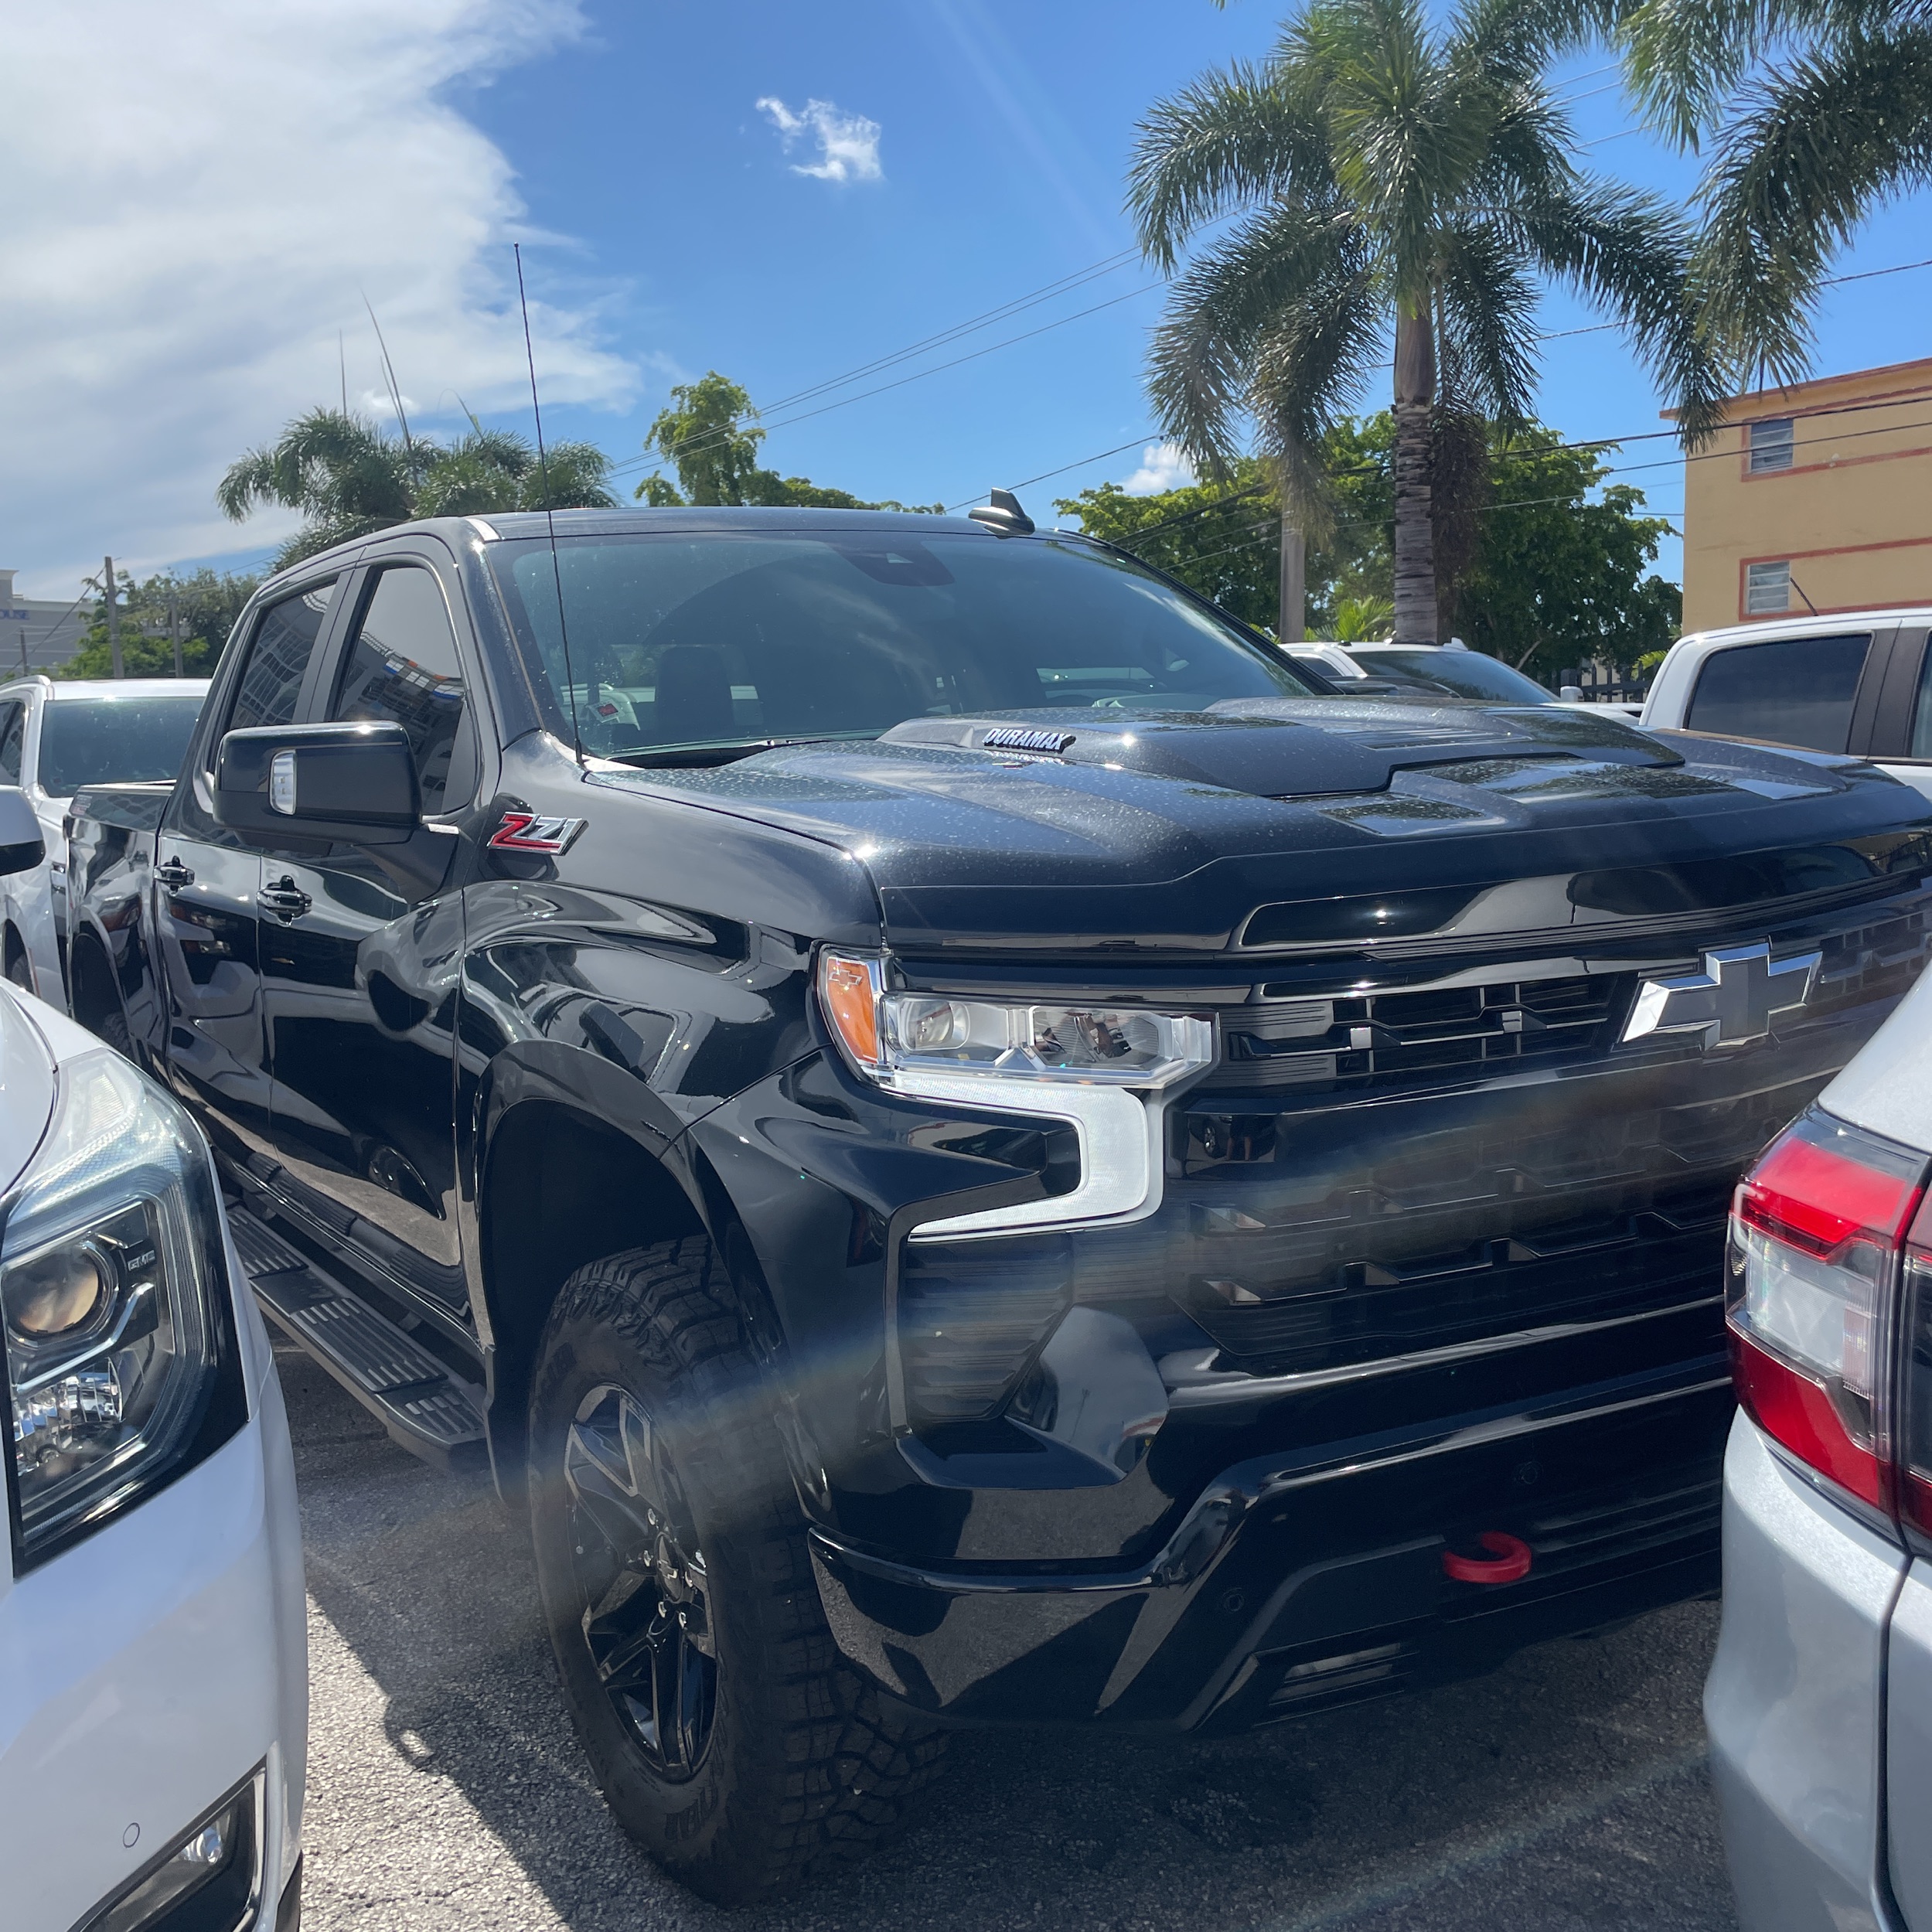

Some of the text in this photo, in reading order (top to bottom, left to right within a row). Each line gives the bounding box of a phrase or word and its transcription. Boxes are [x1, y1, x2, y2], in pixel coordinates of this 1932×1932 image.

[982, 727, 1075, 753] DURAMAX
[486, 811, 588, 856] Z71
[128, 1249, 155, 1271] GMC
